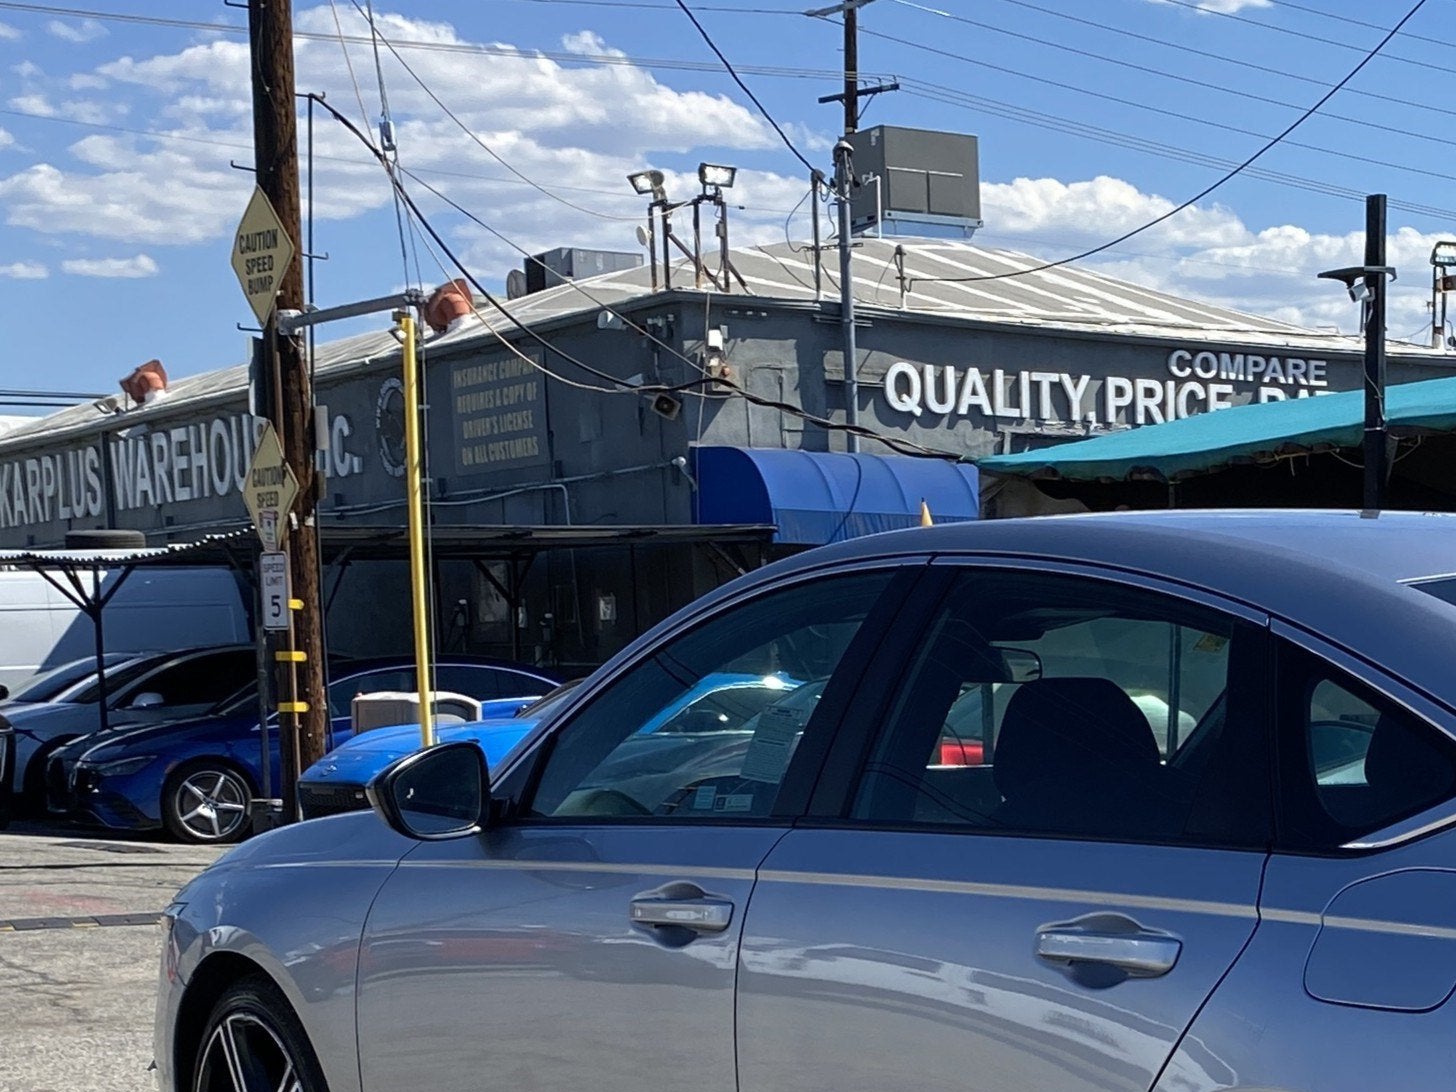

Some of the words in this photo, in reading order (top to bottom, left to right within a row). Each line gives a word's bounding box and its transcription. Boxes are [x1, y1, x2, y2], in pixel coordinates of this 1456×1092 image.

[239, 229, 278, 254] CAUTION
[245, 255, 274, 275] SPEED
[247, 275, 274, 296] BUMP
[453, 362, 498, 389] INSURANCE
[1170, 349, 1328, 387] COMPARE
[457, 389, 495, 414] REQUIRES
[495, 388, 502, 407] A
[502, 384, 525, 406] COPY
[525, 381, 537, 402] OF
[885, 361, 1097, 431] QUALITY,
[462, 415, 498, 439] DRIVER'S
[500, 410, 534, 433] LICENSE
[462, 447, 473, 466] ON
[474, 444, 488, 464] ALL
[488, 436, 539, 462] CUSTOMERS
[0, 446, 102, 528] KARPLUS
[252, 465, 284, 488] CAUTION
[256, 490, 279, 509] SPEED
[263, 562, 285, 573] SPEED
[266, 575, 284, 587] LIMIT
[270, 594, 282, 618] 5
